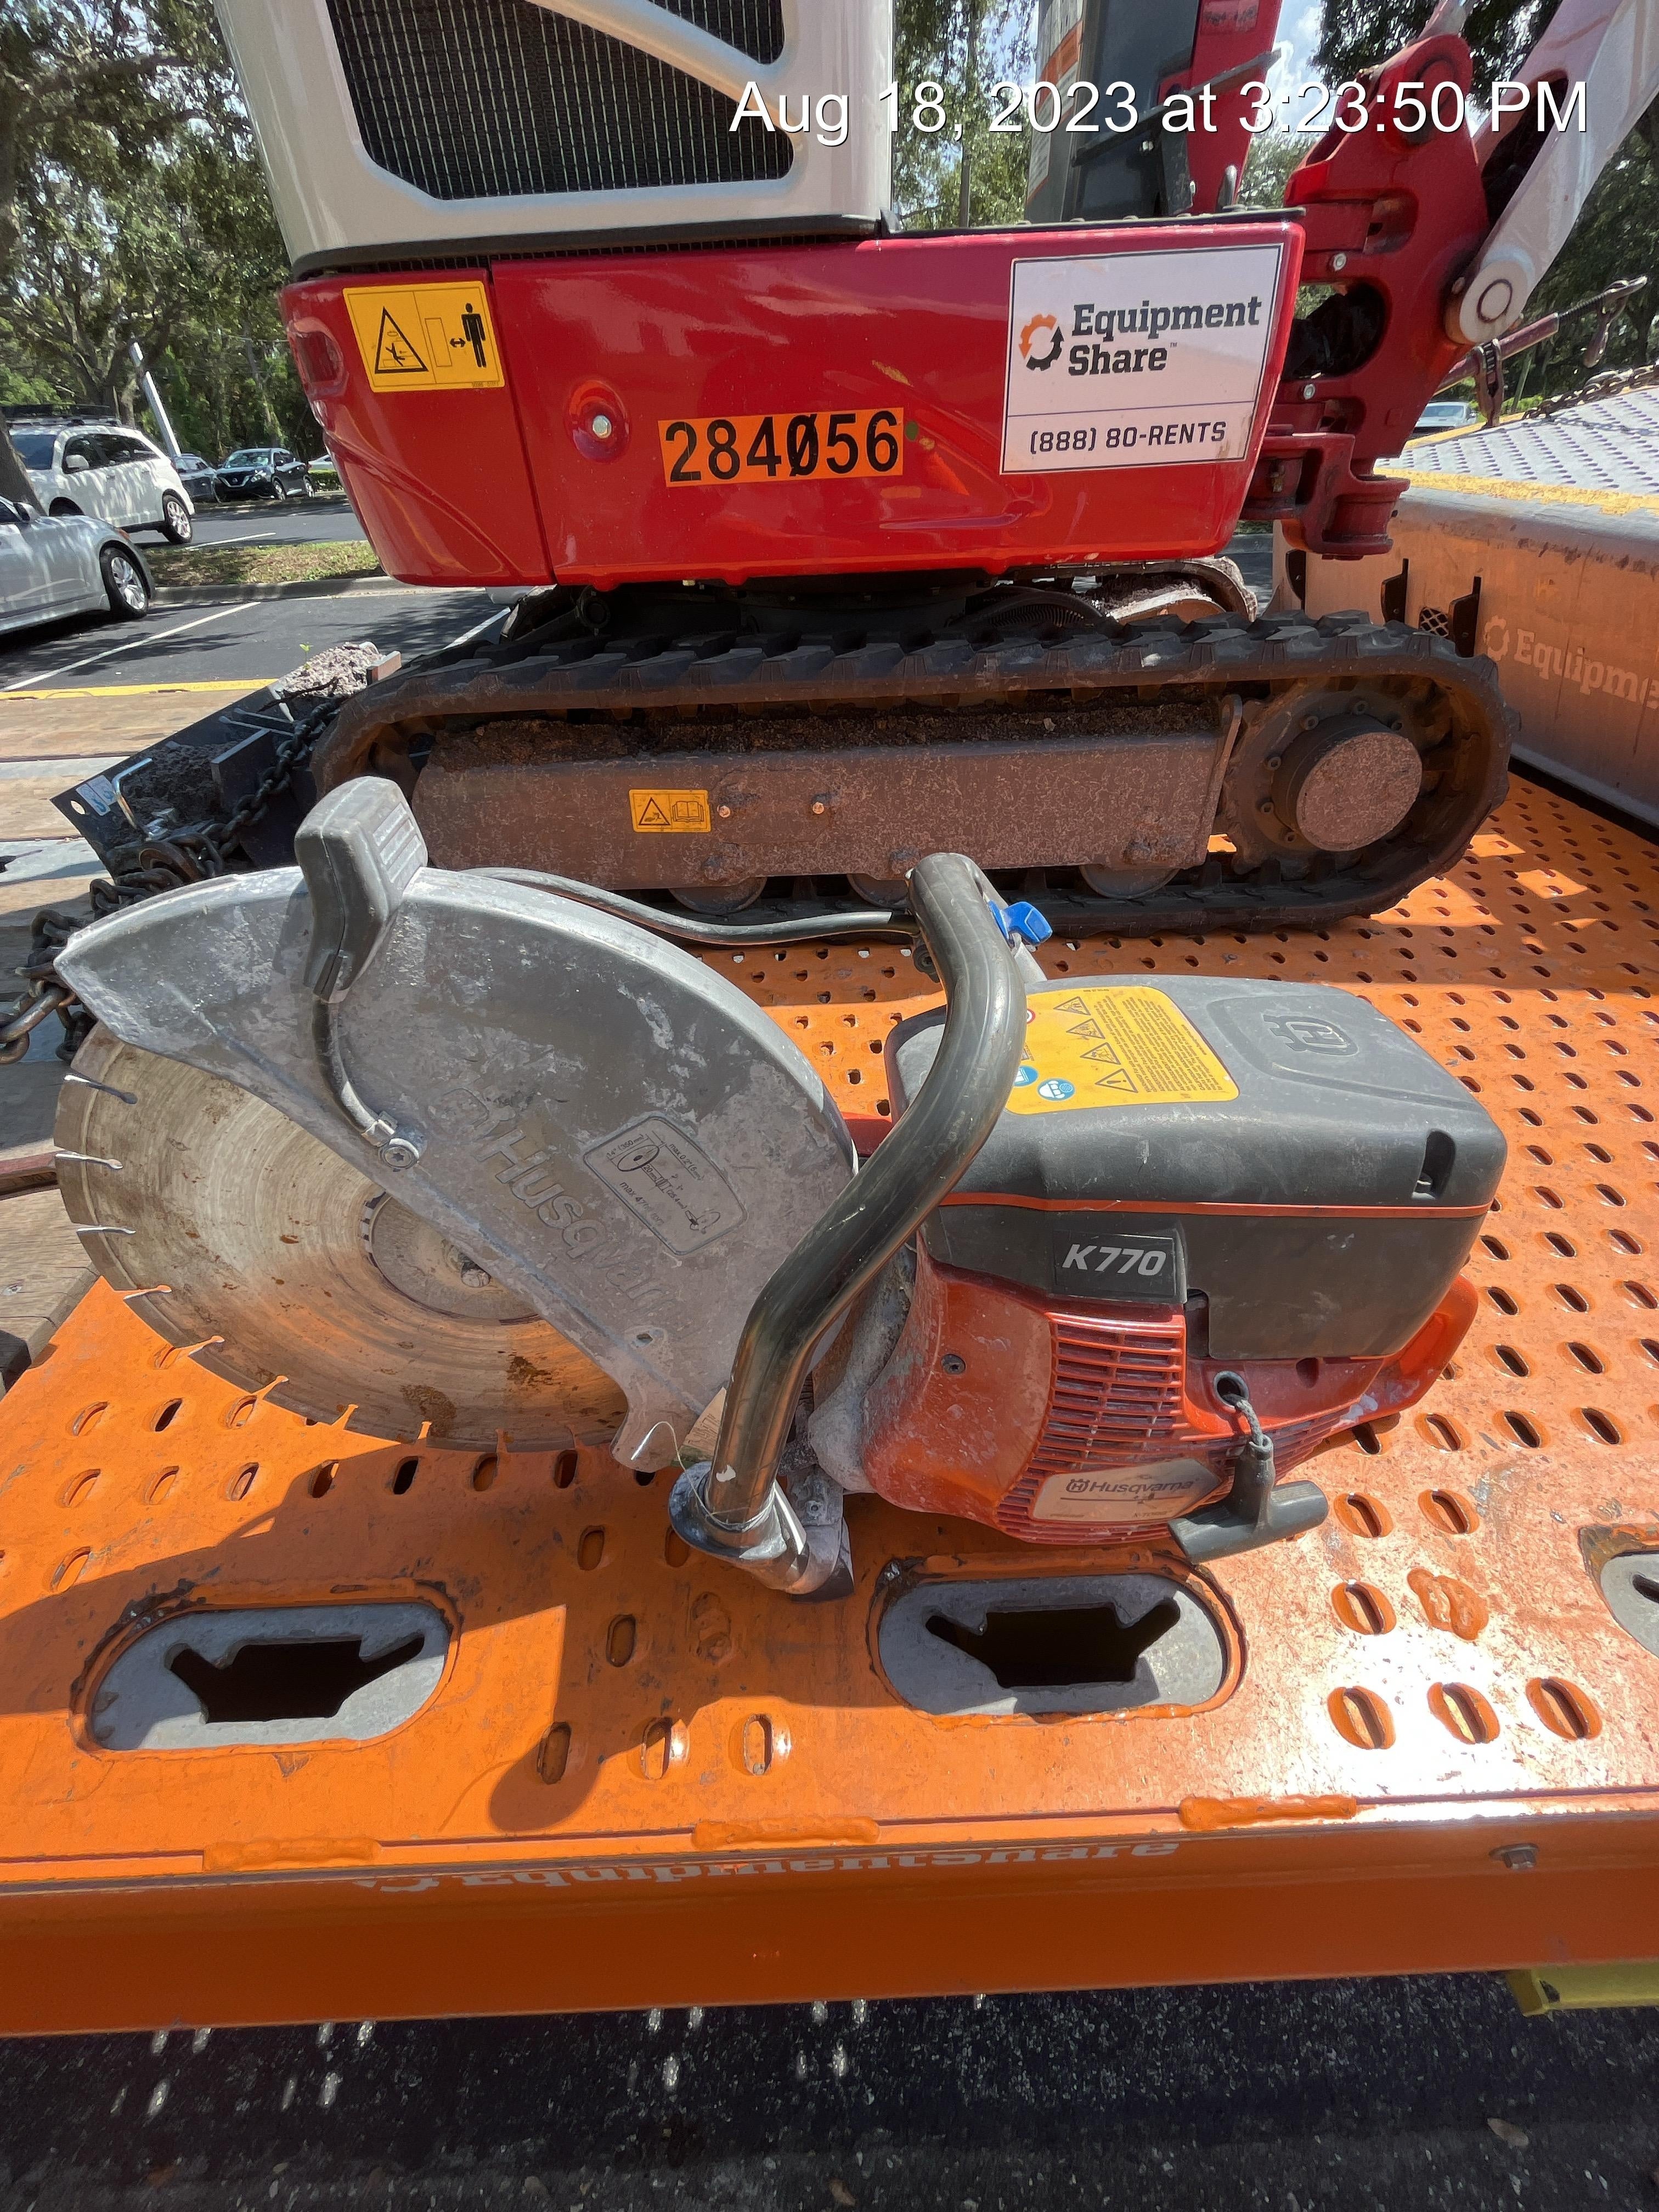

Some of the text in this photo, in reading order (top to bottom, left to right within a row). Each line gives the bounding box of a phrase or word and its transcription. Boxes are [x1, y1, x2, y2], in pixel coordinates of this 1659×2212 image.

[1071, 296, 1262, 342] Equipment
[1068, 343, 1167, 376] Share
[1030, 421, 1227, 454] (888) 80-RENTS
[669, 1143, 681, 1155] max
[619, 1180, 637, 1198] max
[1089, 1480, 1194, 1494] Husqvarna
